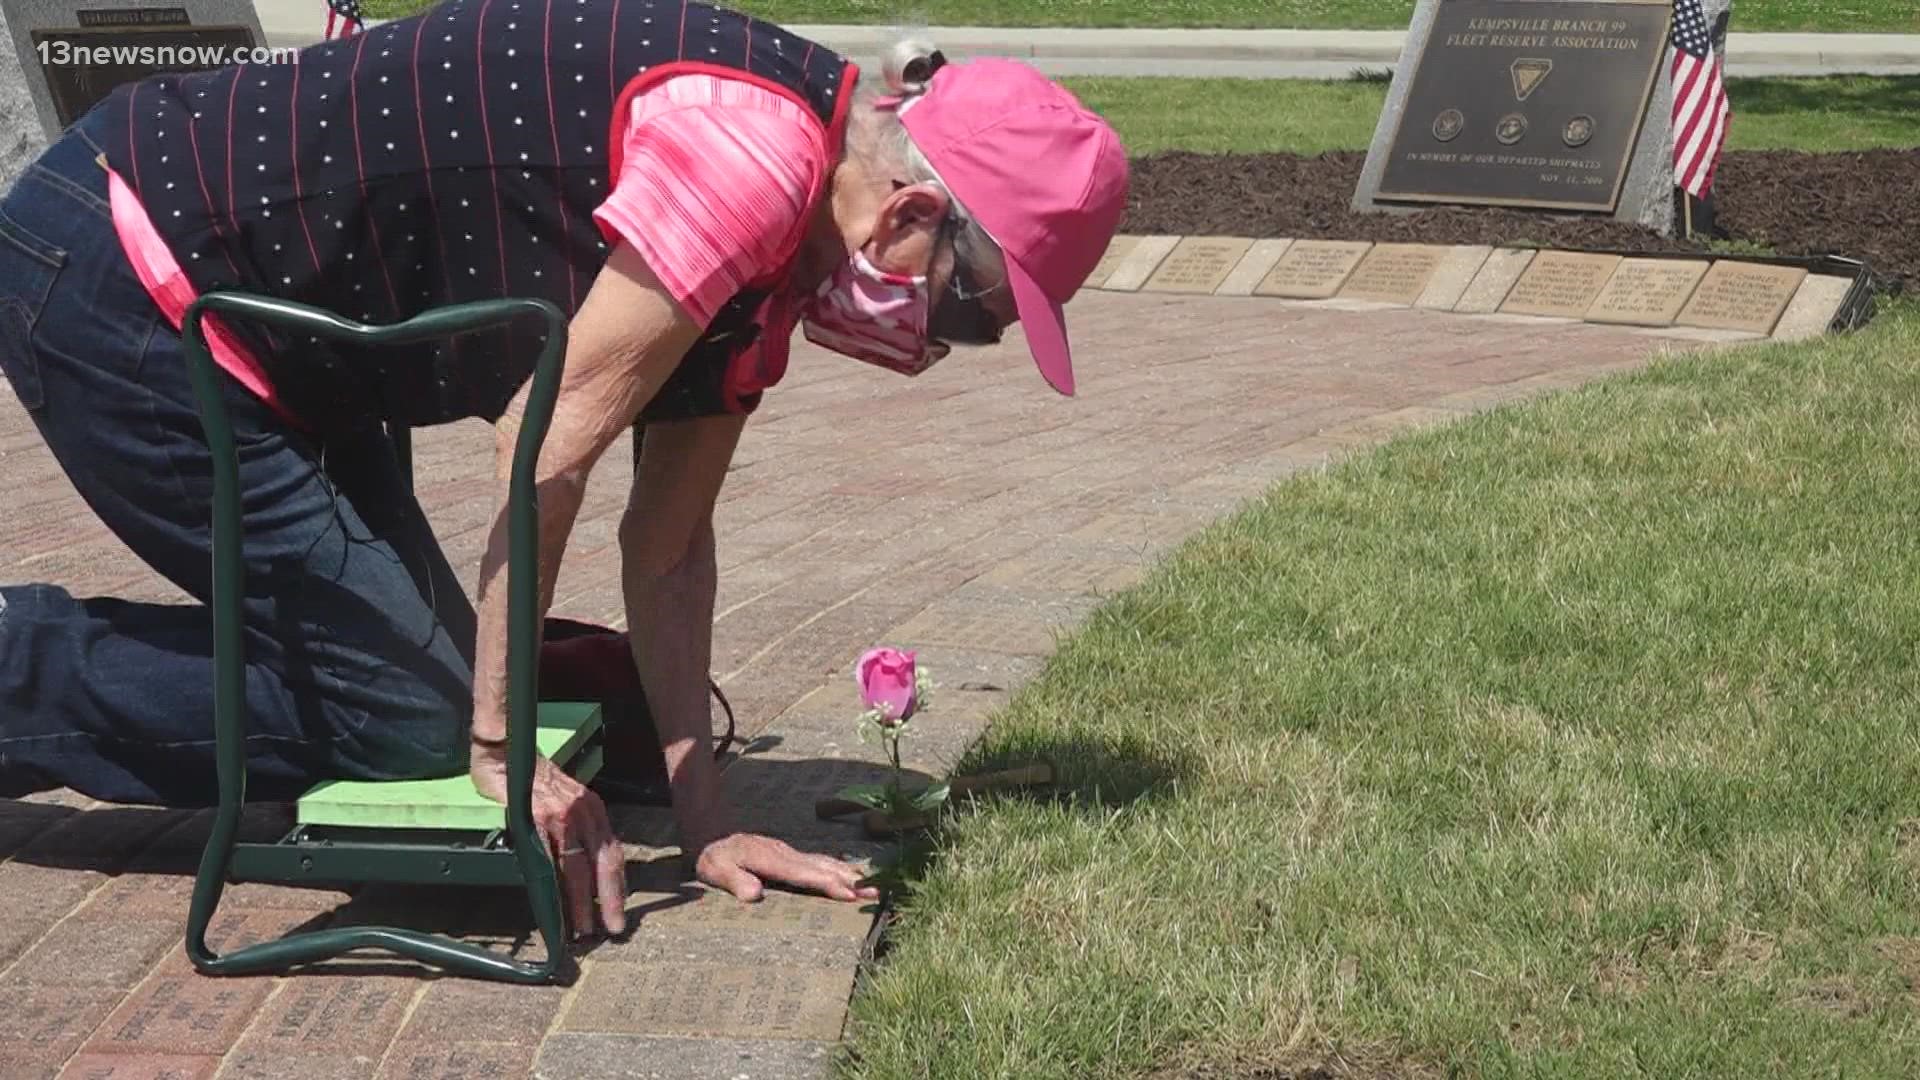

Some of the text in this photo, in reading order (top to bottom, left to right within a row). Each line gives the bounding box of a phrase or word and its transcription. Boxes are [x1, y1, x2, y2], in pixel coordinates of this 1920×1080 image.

[1468, 17, 1627, 33] KEMPSVILLE BRANCH 99
[1446, 34, 1639, 49] FLEET RESERVE ASSOCIATION
[1406, 152, 1600, 169] IN MEMORY OF OUR DEPARTED SHIPMATES
